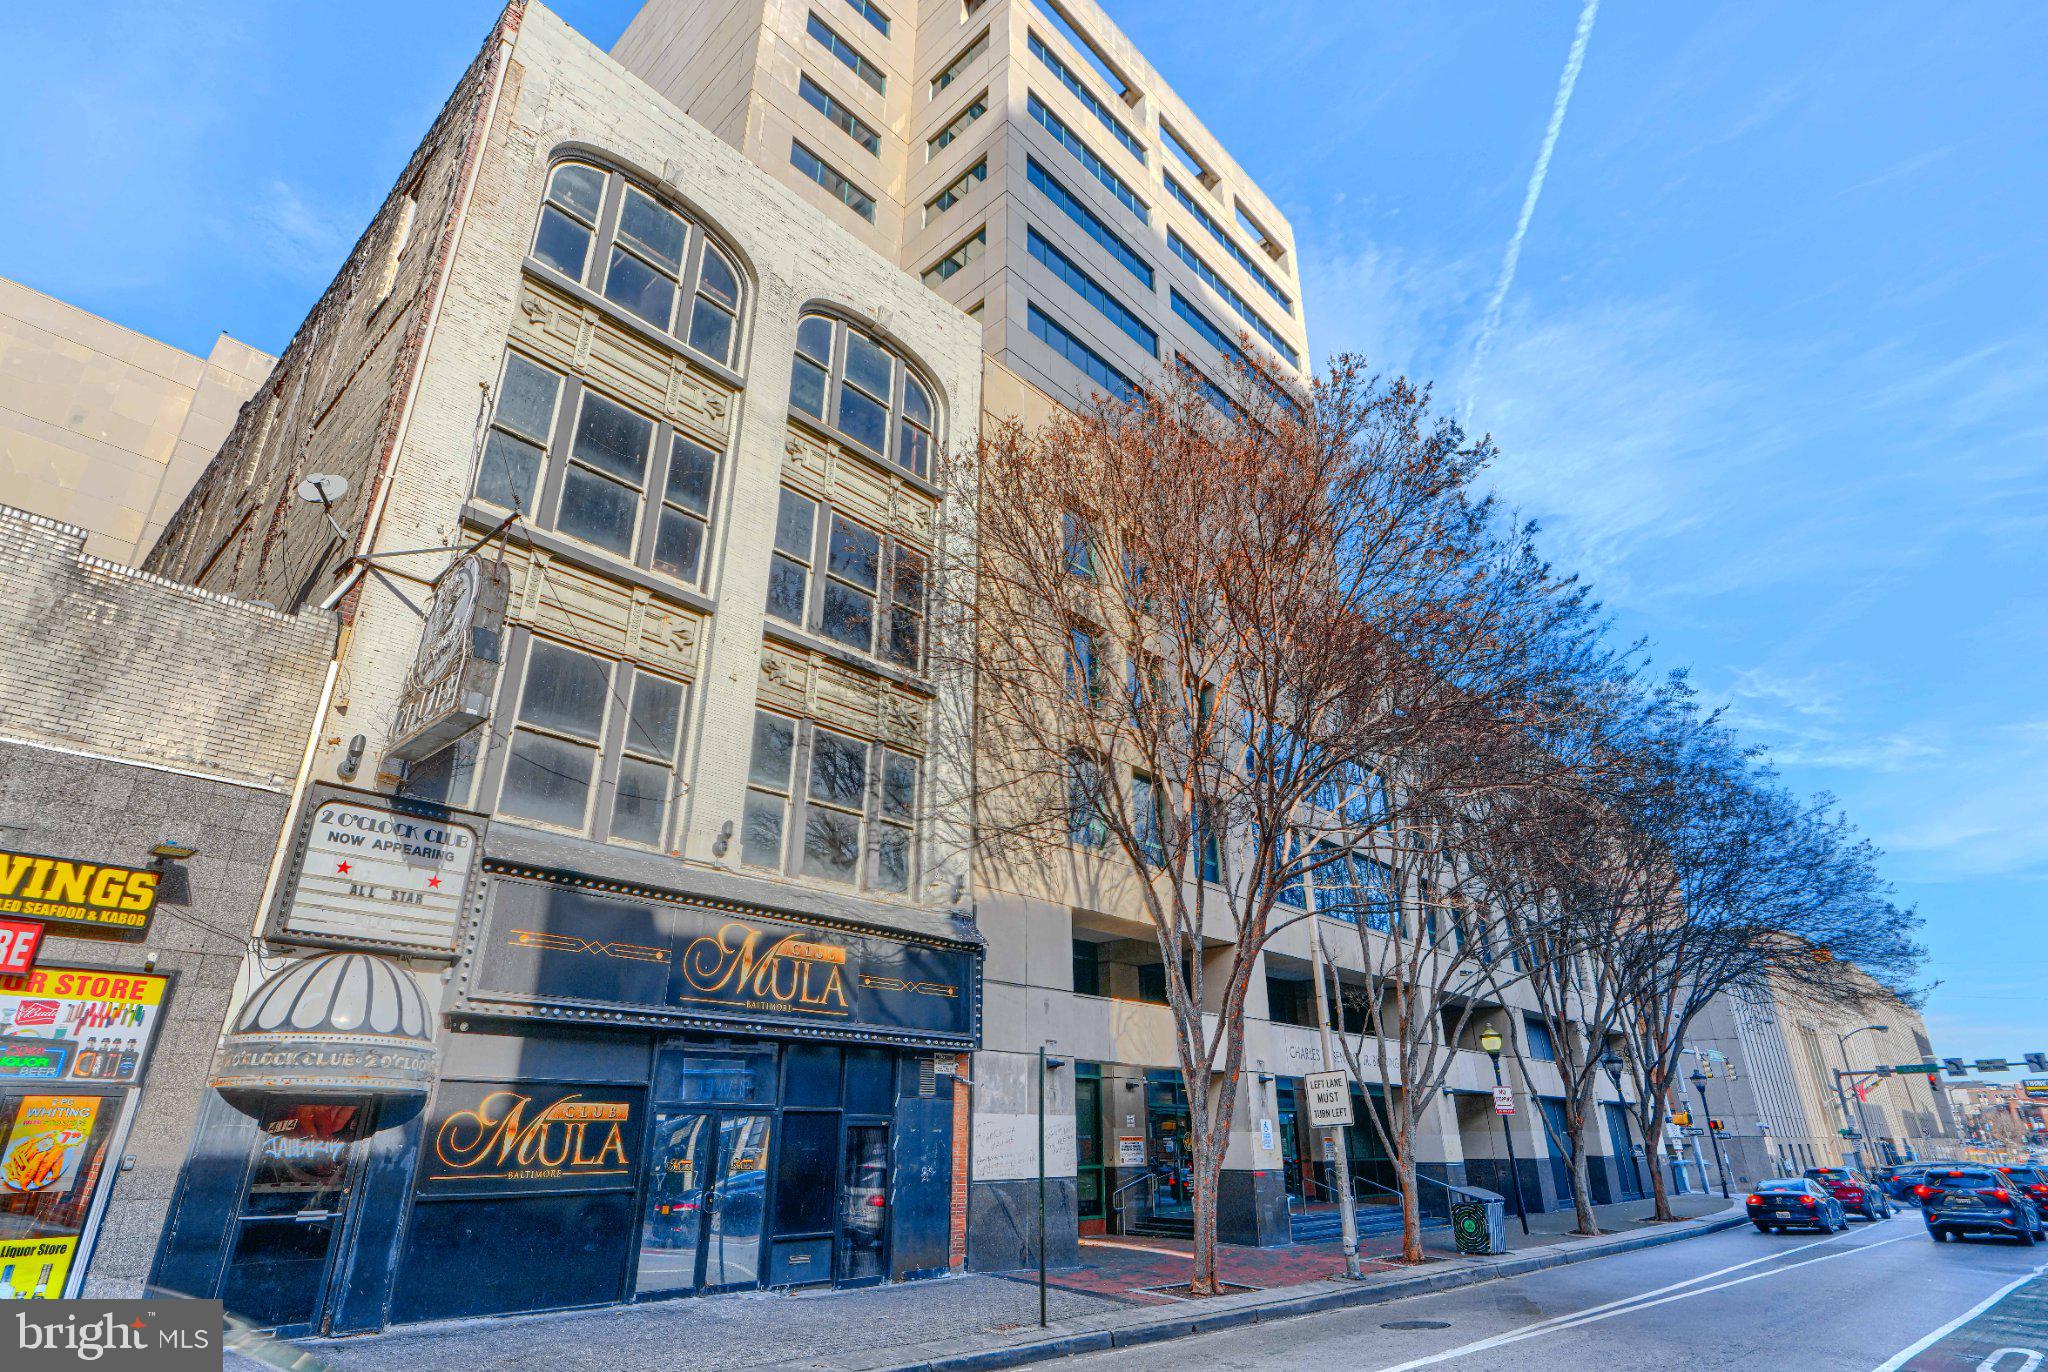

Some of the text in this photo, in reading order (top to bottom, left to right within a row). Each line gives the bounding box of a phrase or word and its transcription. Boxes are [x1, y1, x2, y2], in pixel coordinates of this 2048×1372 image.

[320, 809, 470, 849] 2 O'CLOCK CLUB
[327, 831, 455, 862] NOW APPEARING
[350, 884, 424, 905] ALL STAR
[24, 902, 87, 919] SEAFOOD
[87, 910, 98, 921] &
[99, 910, 147, 927] KABOB
[54, 974, 148, 1000] STORE
[302, 1051, 358, 1067] CLUB
[1310, 1078, 1343, 1090] LEFT LANE
[1317, 1092, 1339, 1103] MUST
[26, 1107, 91, 1118] WHITING
[564, 1105, 618, 1119] CLUB
[1313, 1107, 1347, 1119] TURN LEFT
[507, 1169, 562, 1180] BALTIMORE
[0, 1243, 67, 1258] Liquor Store
